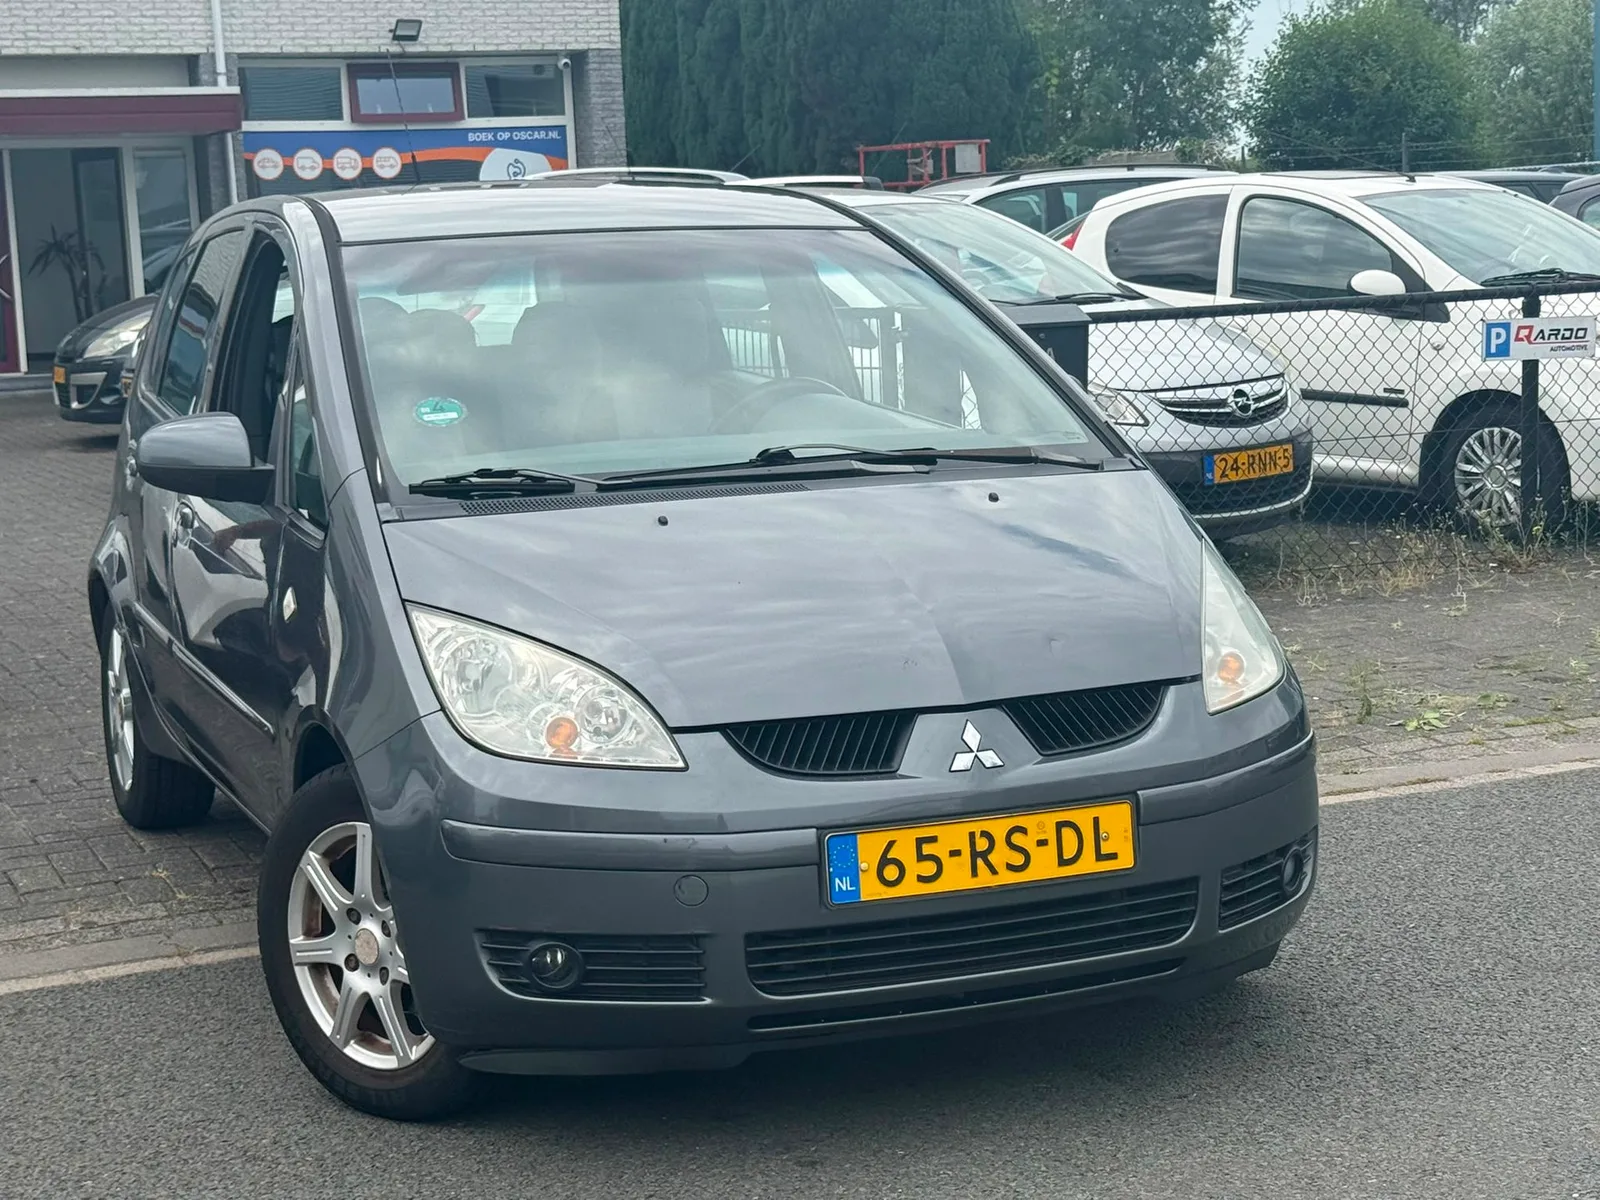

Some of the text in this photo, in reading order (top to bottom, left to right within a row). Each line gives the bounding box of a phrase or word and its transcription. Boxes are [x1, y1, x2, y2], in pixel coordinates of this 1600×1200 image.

[467, 130, 561, 142] BOEK OP OSCAR.NL
[1490, 327, 1507, 354] P
[1549, 344, 1589, 352] AUTOMOTIVE
[1219, 448, 1291, 479] 24-RNN-5
[876, 816, 1118, 888] 65-RS-DL
[834, 876, 856, 892] NL
